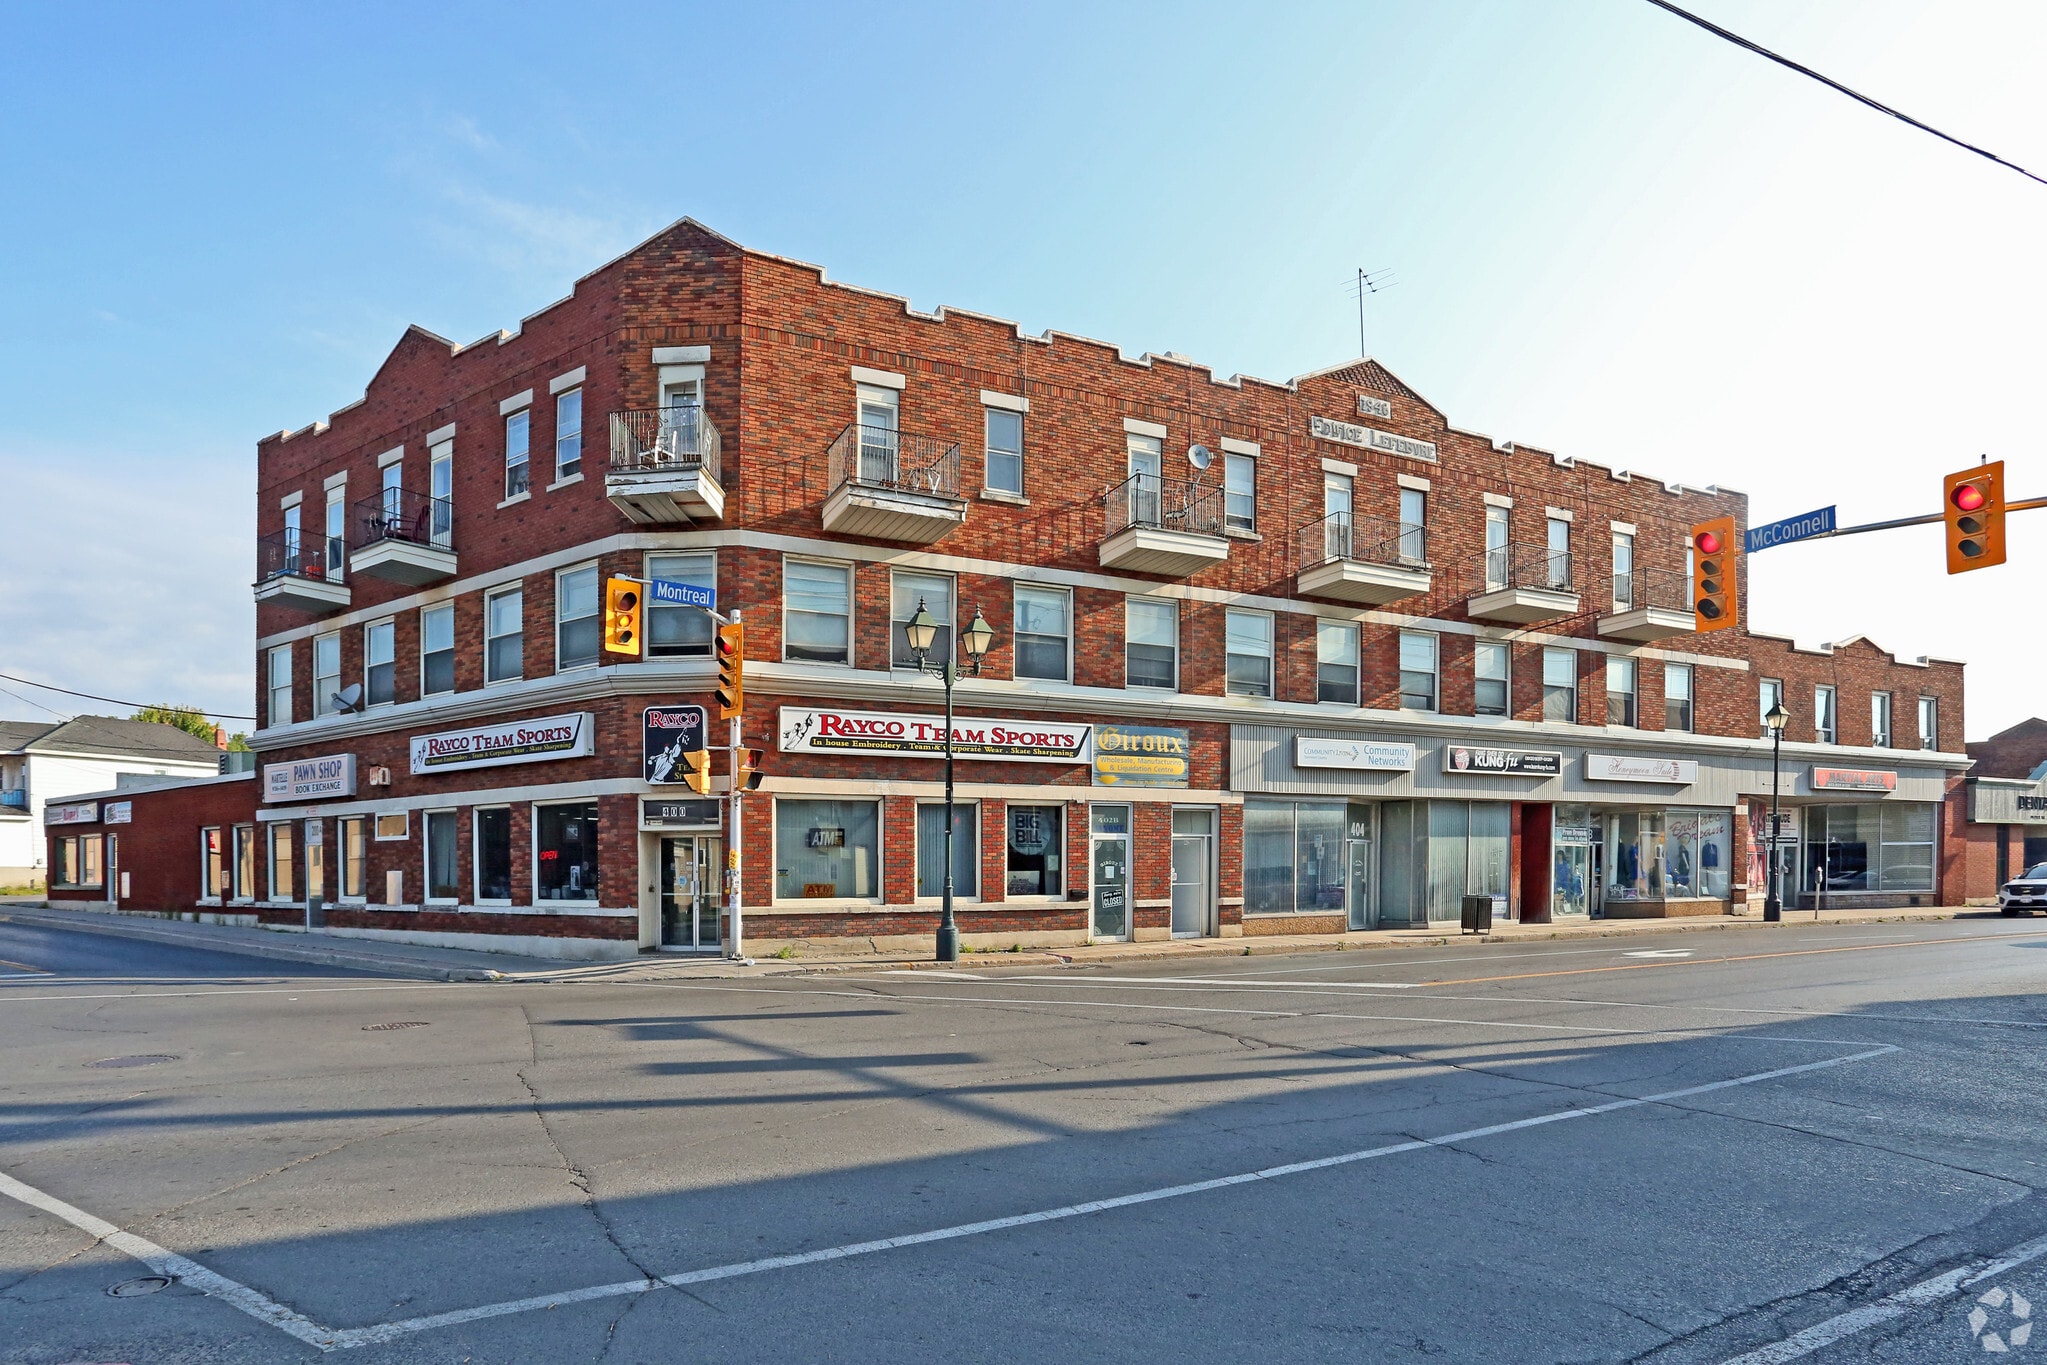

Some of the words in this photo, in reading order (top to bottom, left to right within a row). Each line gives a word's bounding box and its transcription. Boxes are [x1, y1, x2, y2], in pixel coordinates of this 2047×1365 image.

[1751, 510, 1829, 549] McConnell
[657, 582, 710, 605] Montreal
[648, 710, 700, 728] RAYCO
[818, 714, 905, 739] RAYCO
[911, 723, 985, 743] TEAM
[991, 727, 1075, 747] SPORTS
[428, 738, 469, 757] RAYCO
[472, 734, 514, 751] TEAM
[517, 726, 572, 745] SPORTS
[1098, 726, 1183, 753] Giroux
[812, 738, 822, 746] In
[825, 738, 849, 747] house
[852, 740, 901, 751] Embroidery
[1010, 747, 1031, 755] Skate
[1032, 749, 1074, 757] Sharpening
[1363, 744, 1410, 758] Community
[1117, 764, 1152, 773] Liquidation
[1368, 755, 1406, 767] Networks
[293, 763, 316, 782] PAWN
[318, 760, 342, 779] SHOP
[295, 784, 310, 794] BOOK
[312, 781, 341, 792] EXCHANGE
[662, 806, 686, 817] 400
[1015, 814, 1040, 829] BIG
[1015, 829, 1042, 844] BILL
[1351, 822, 1365, 837] 404
[811, 831, 835, 846] ATM
[540, 850, 558, 861] OPEN
[806, 884, 834, 894] ATM
[1103, 895, 1123, 908] CLOSED
